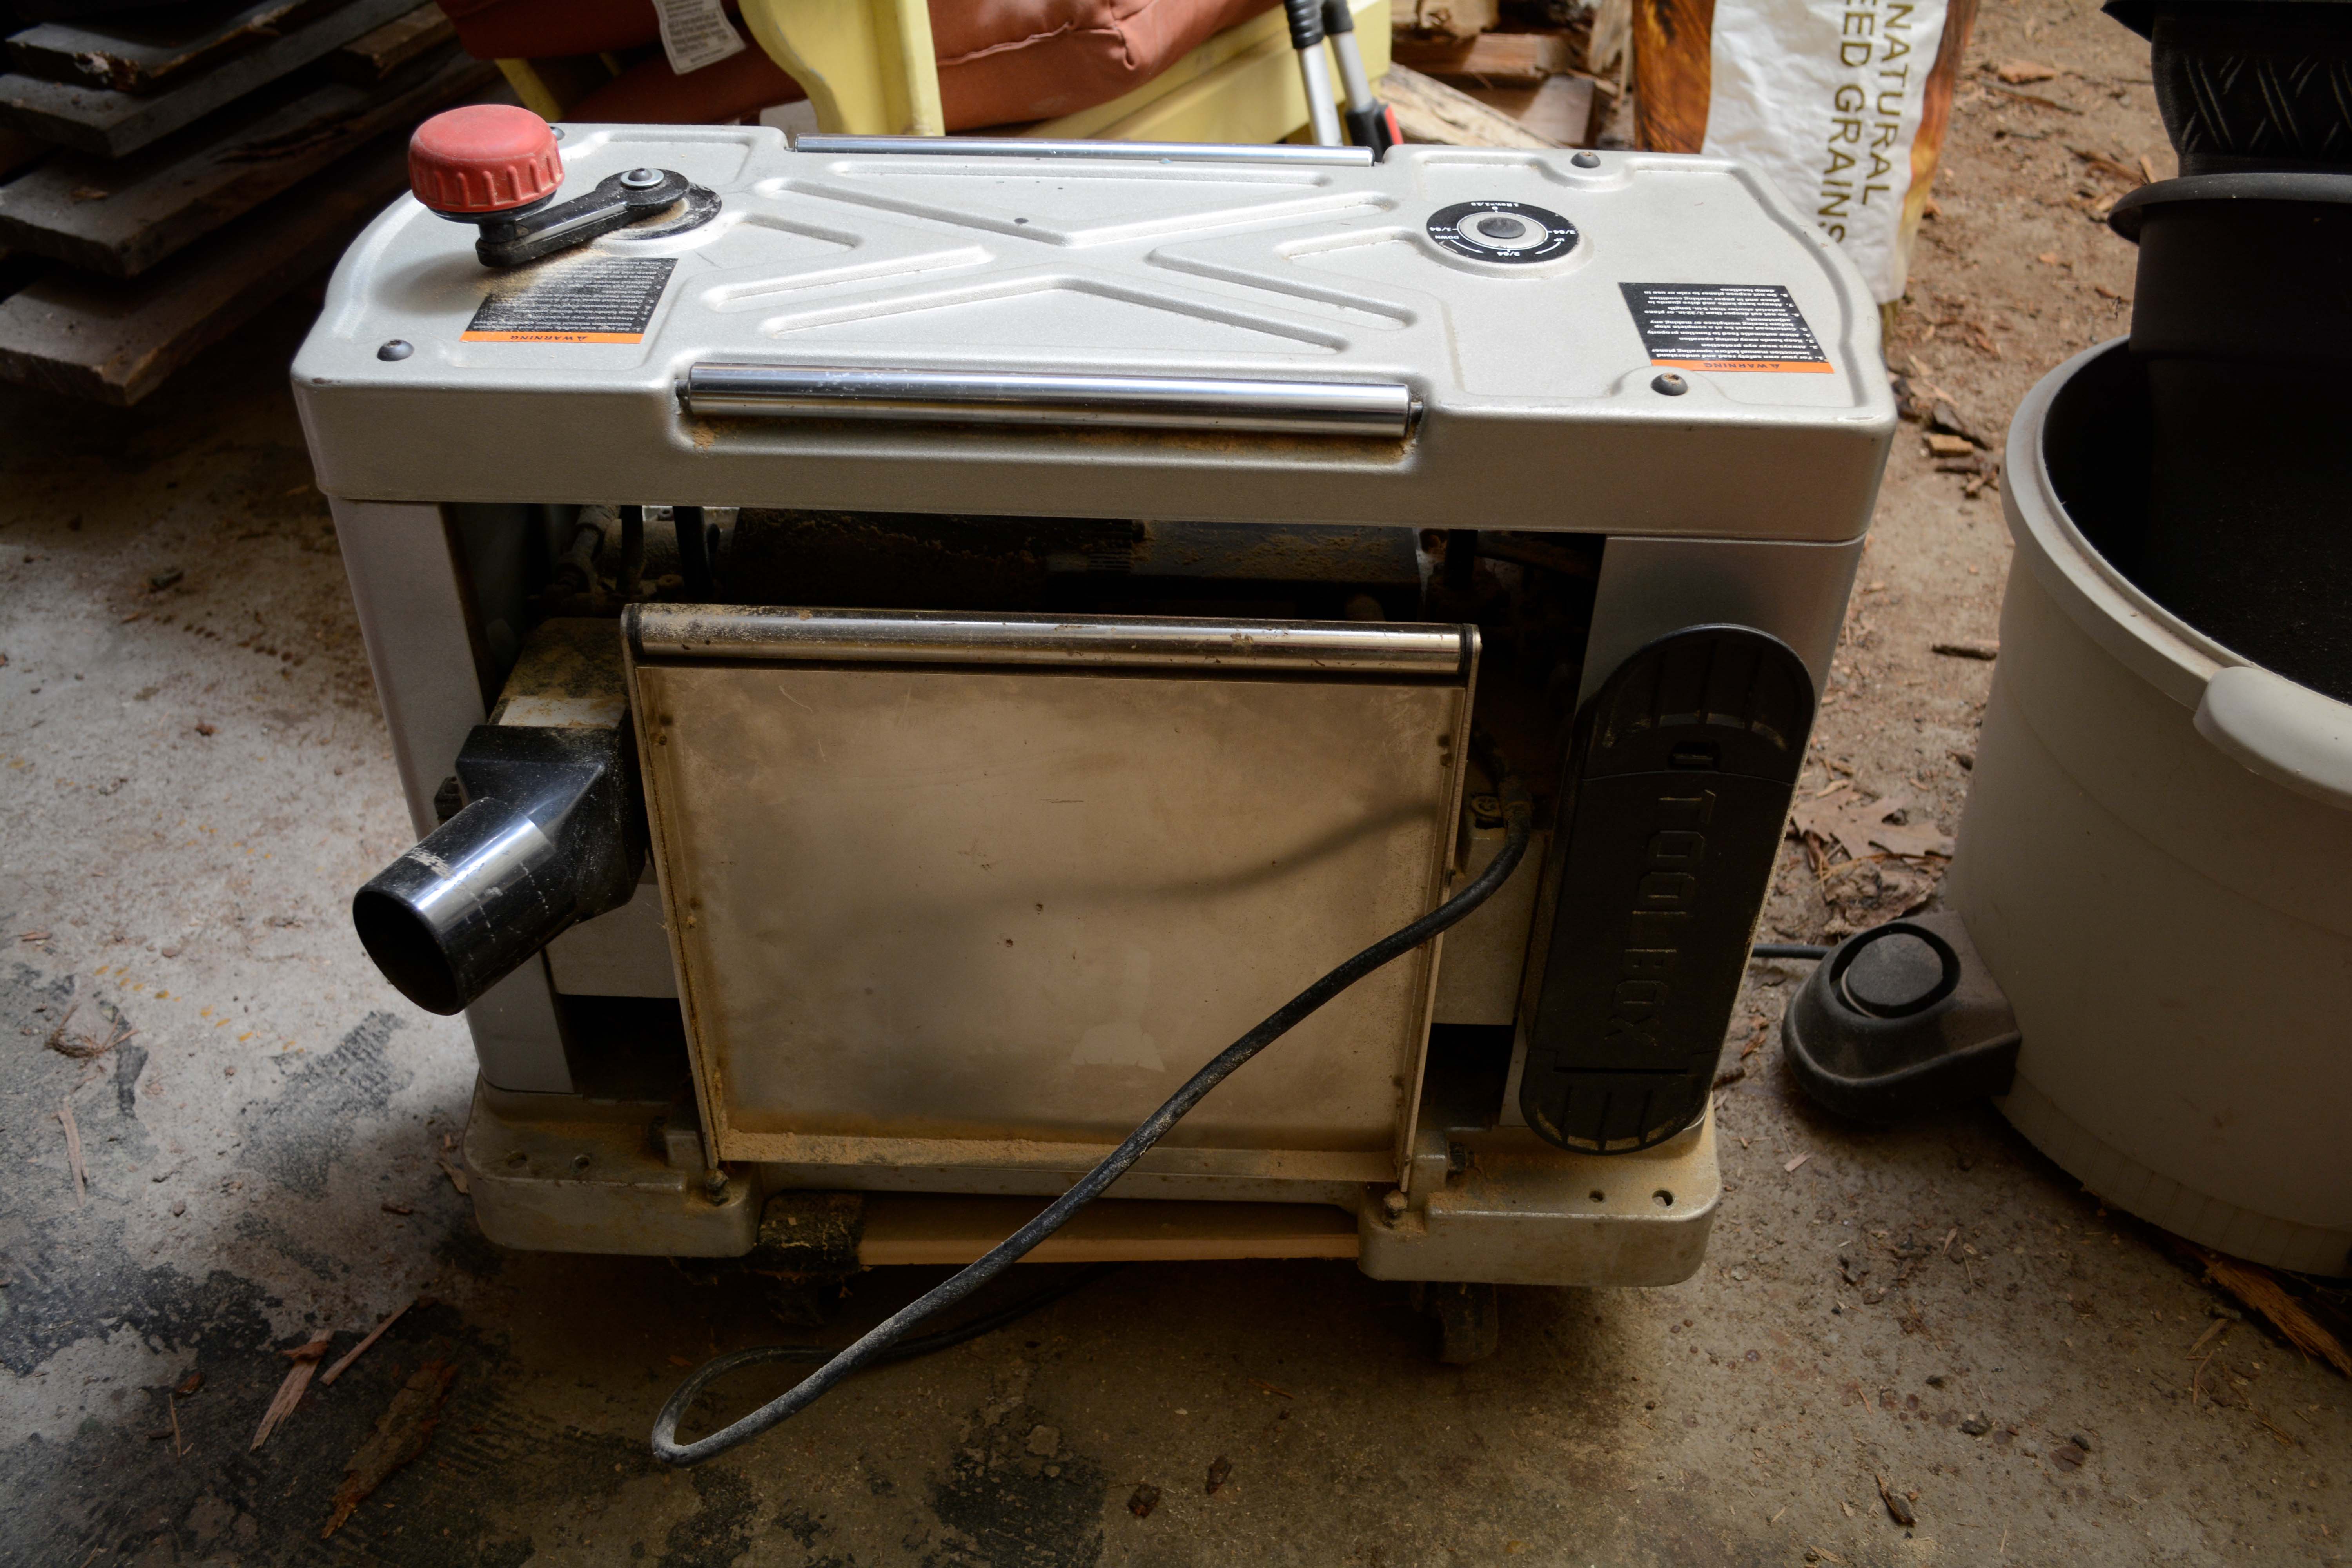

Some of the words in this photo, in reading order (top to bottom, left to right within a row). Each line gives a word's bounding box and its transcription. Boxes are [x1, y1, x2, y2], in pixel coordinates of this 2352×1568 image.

[1840, 0, 1877, 67] ED
[1862, 3, 1913, 205] NATURAL
[1604, 789, 1717, 1047] TOOLBOX
